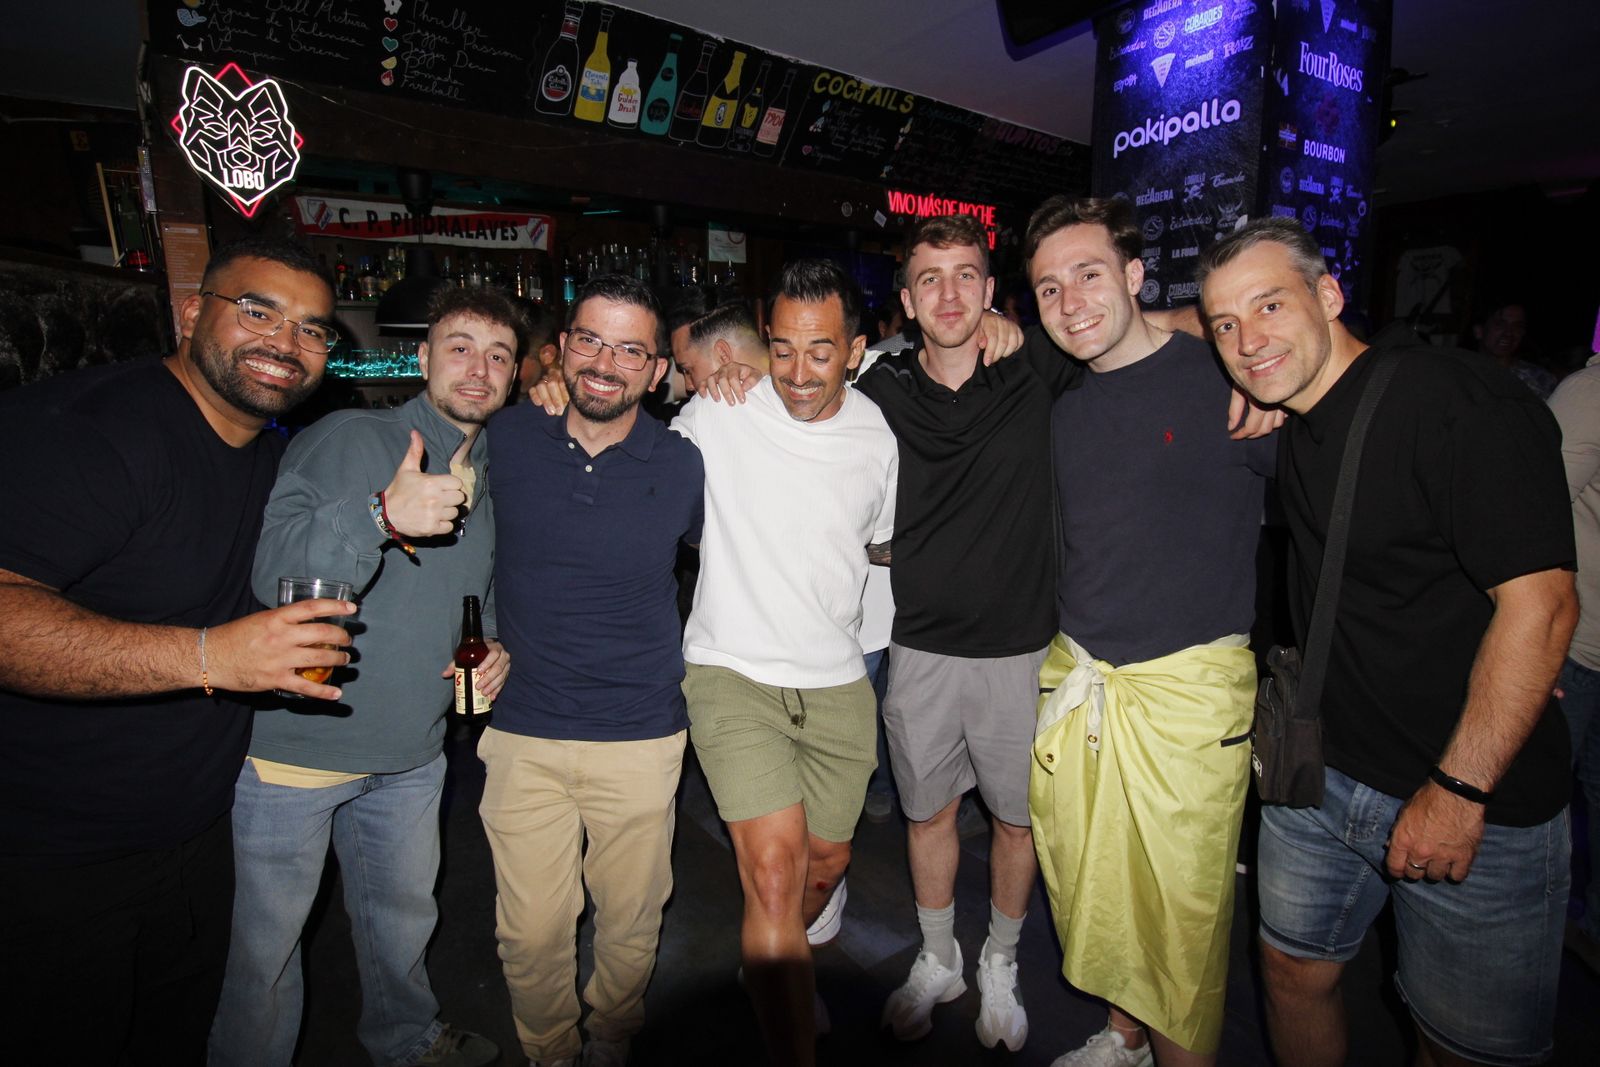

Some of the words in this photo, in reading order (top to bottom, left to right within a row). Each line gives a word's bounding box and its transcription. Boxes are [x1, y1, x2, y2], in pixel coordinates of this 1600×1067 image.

[1113, 98, 1241, 159] pakipalla
[1303, 139, 1346, 164] BOURBON
[223, 168, 265, 190] LOBO
[888, 190, 916, 215] VIVO
[917, 193, 942, 218] MÁS
[959, 202, 997, 226] NOCHE
